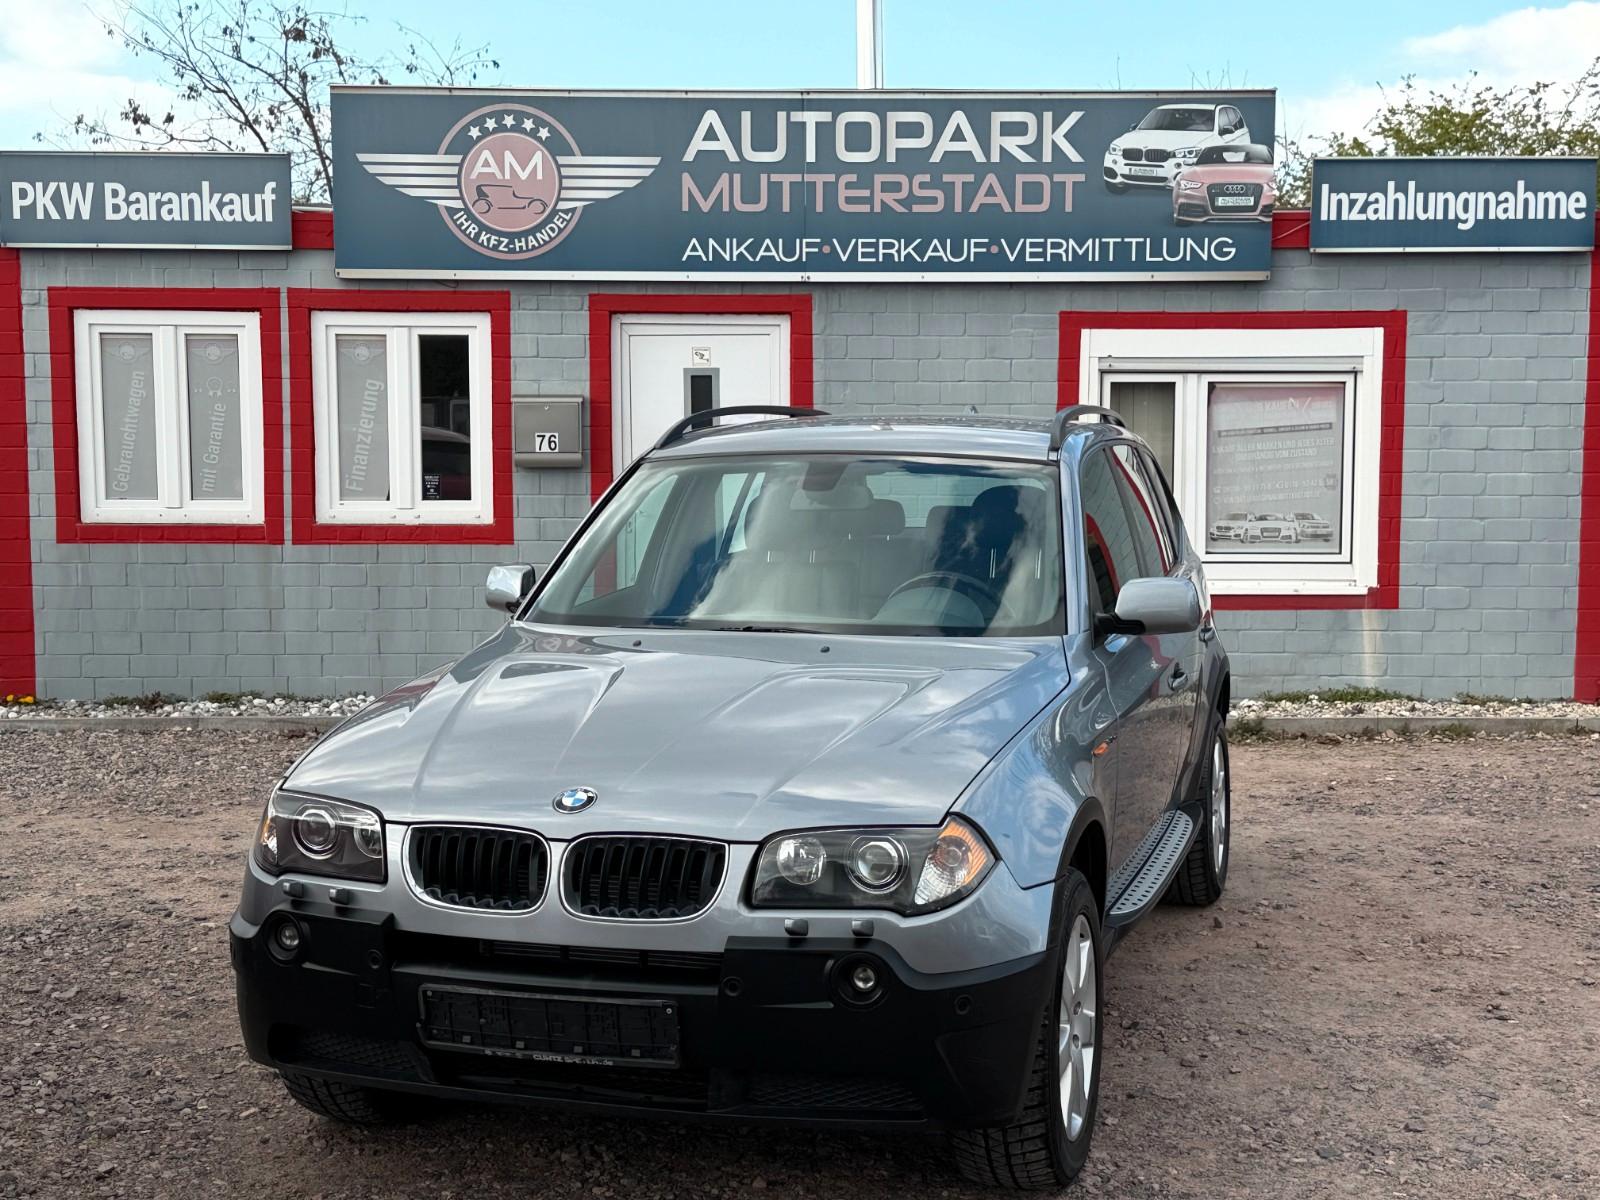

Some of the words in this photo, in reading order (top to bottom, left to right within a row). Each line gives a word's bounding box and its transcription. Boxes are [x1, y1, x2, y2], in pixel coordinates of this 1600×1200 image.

[682, 108, 1085, 164] AUTOPARK
[469, 149, 543, 180] AM
[11, 181, 95, 220] PKW
[104, 180, 277, 223] Barankauf
[681, 171, 1086, 214] MUTTERSTADT
[1320, 179, 1588, 231] Inzahlungnahme
[453, 210, 479, 239] IHR
[478, 211, 572, 252] KFZ-HANDEL
[112, 370, 146, 492] Gebrauchtwagen
[202, 402, 227, 465] Garantie
[345, 378, 385, 492] Finanzierung
[536, 433, 558, 451] 76
[200, 469, 216, 492] mit
